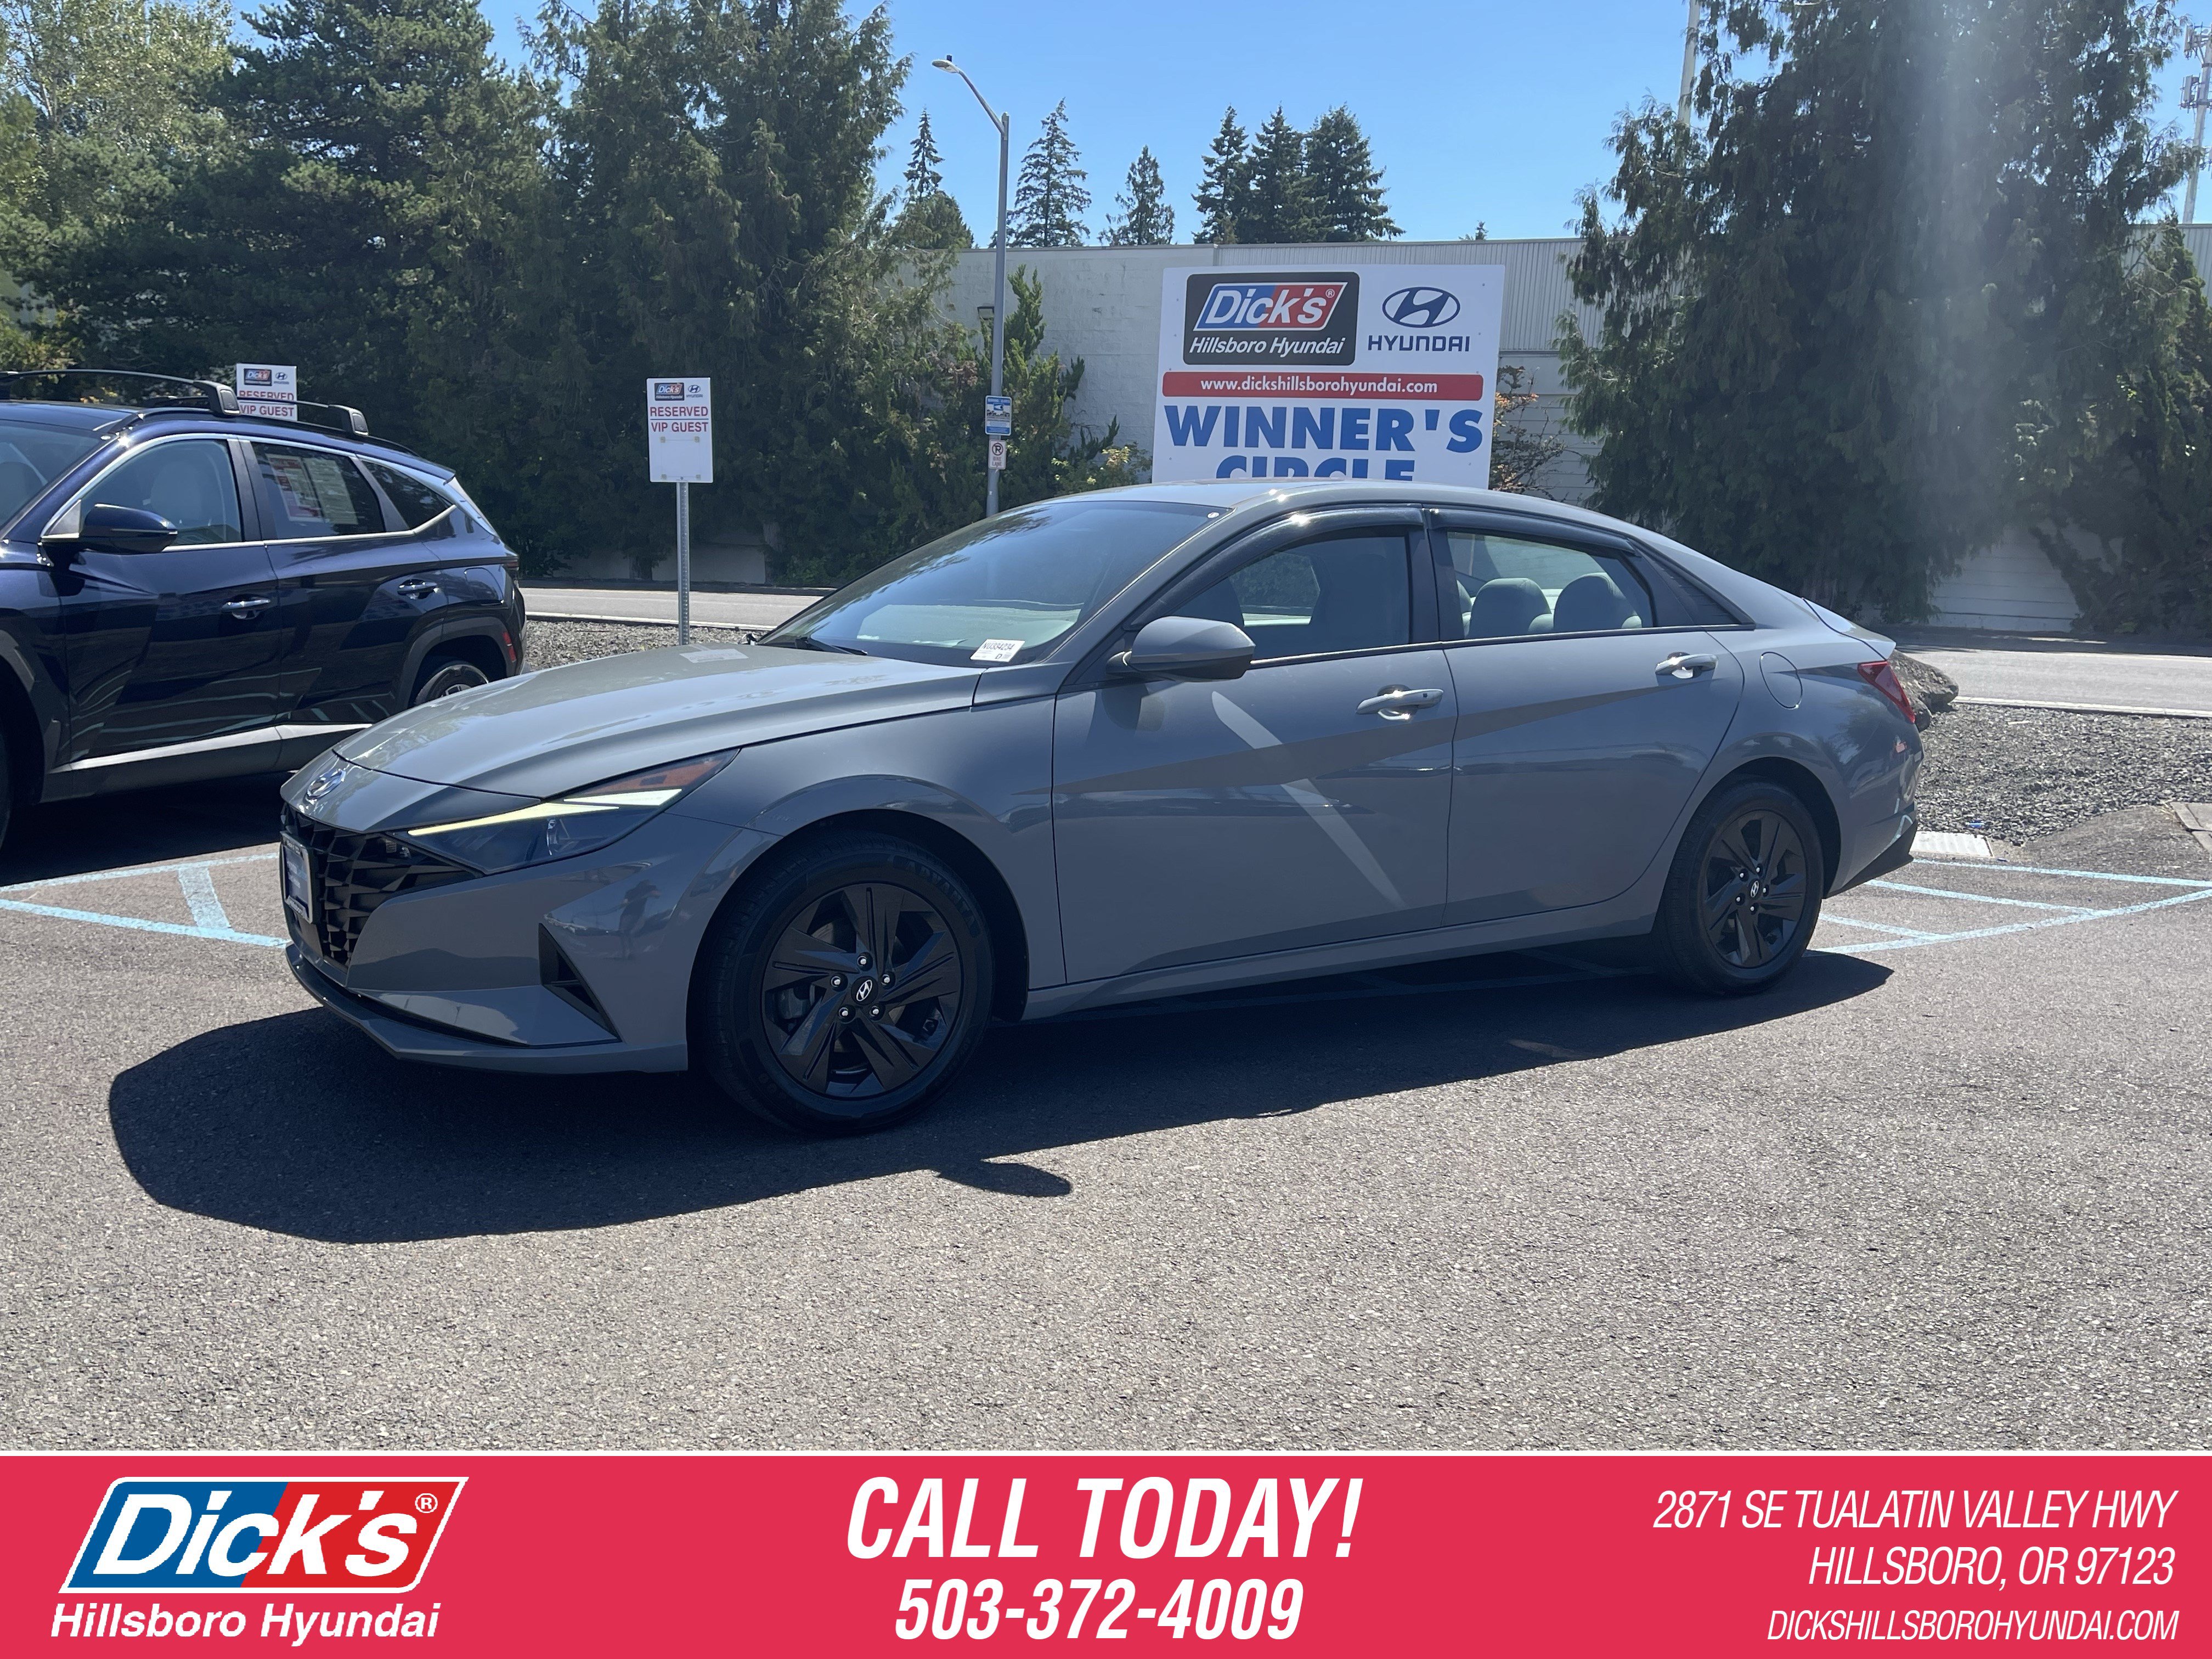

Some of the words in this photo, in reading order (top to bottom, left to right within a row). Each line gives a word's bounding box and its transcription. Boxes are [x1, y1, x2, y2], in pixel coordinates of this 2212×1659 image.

[1189, 337, 1267, 354] Hillsboro
[1269, 337, 1346, 358] Hyundai
[1368, 335, 1470, 352] HYUNDAI
[1200, 376, 1438, 396] www.dickshillsborohyundai.com
[240, 405, 256, 414] VIP
[259, 406, 295, 416] GUEST
[650, 407, 708, 417] RESERVED
[651, 422, 668, 432] VIP
[672, 422, 708, 432] GUEST
[1164, 405, 1483, 453] WINNER'S
